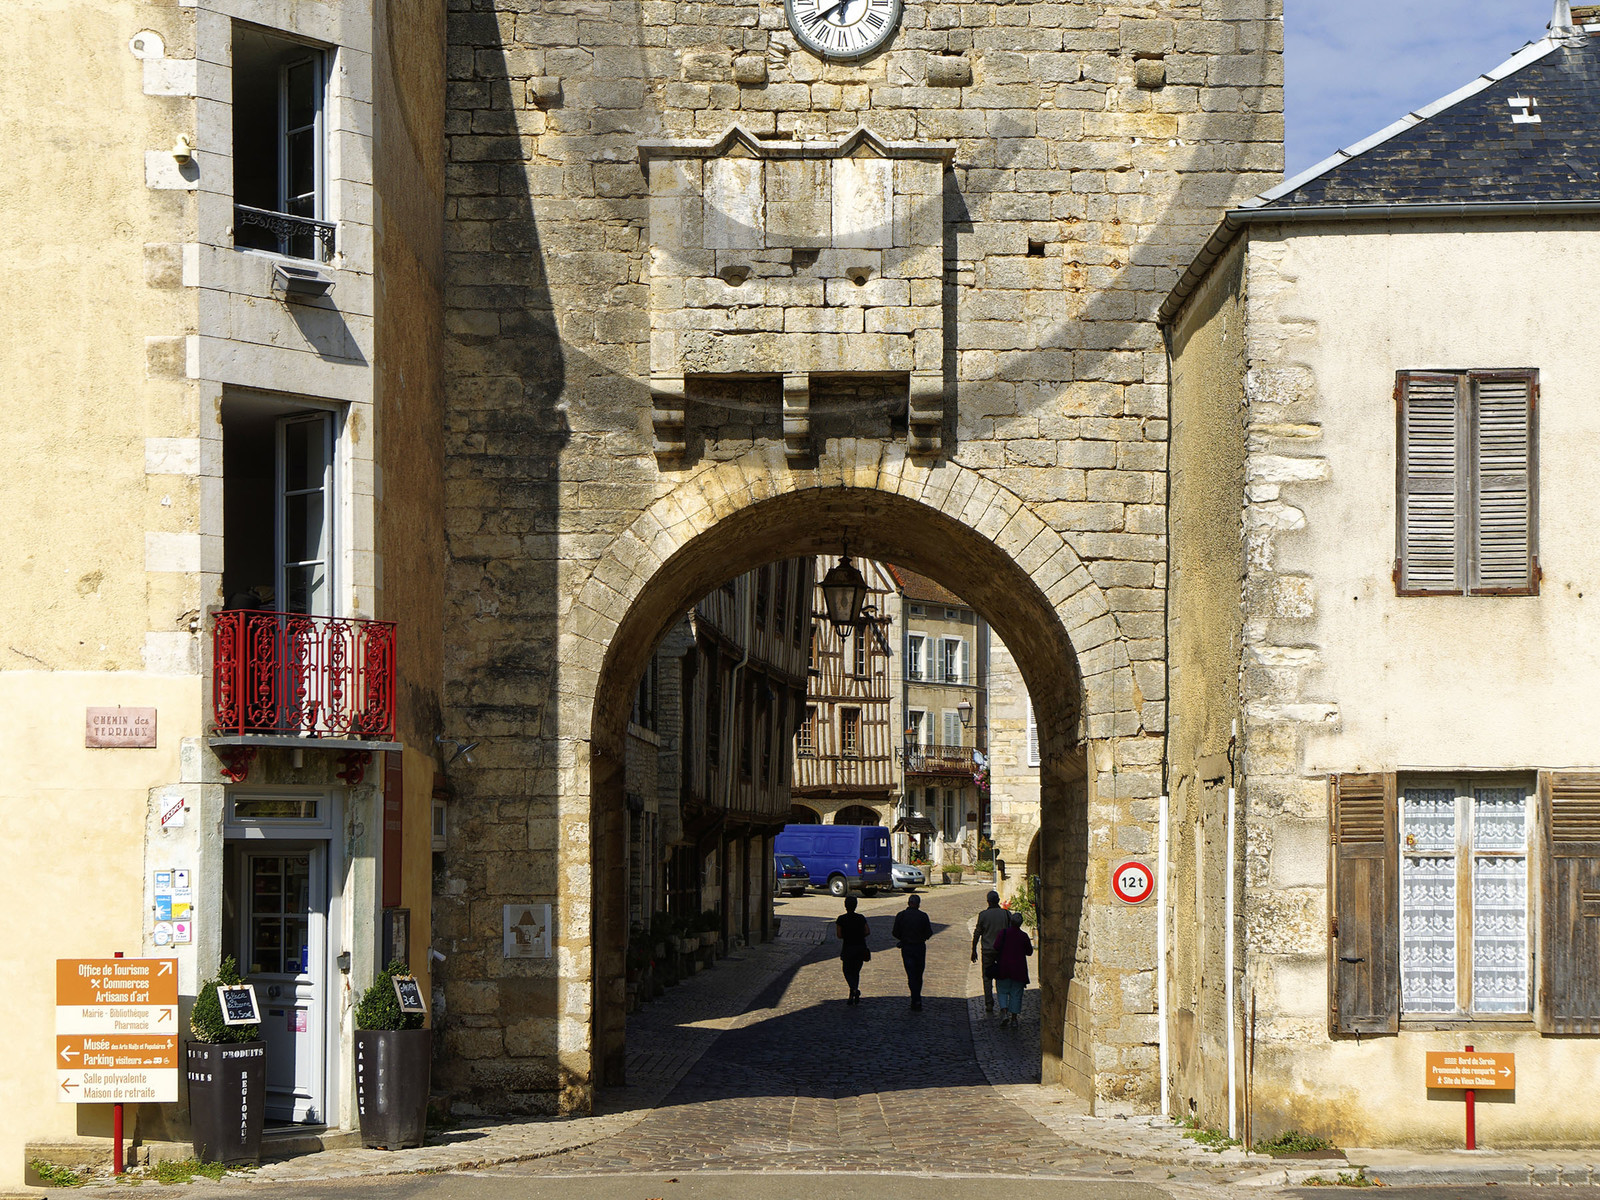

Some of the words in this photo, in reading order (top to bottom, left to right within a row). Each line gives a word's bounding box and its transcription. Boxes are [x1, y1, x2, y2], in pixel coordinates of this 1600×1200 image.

[93, 716, 128, 725] CHEMIN
[134, 716, 149, 725] des
[94, 728, 148, 737] TERREAUX
[78, 964, 101, 977] Office
[102, 964, 112, 976] de
[113, 963, 149, 975] Tourisme
[103, 977, 149, 989] Commerces
[95, 991, 129, 1002] Artisans
[129, 991, 149, 1002] d'art
[82, 1008, 104, 1018] Mairie
[114, 1020, 149, 1029] Pharmacie
[83, 1038, 110, 1050] Musée
[222, 1048, 264, 1059] PRODUITS
[83, 1053, 114, 1067] Parking
[115, 1056, 142, 1065] visiteurs
[83, 1073, 102, 1084] Salle
[103, 1073, 147, 1085] polyvalente
[83, 1087, 112, 1098] Maison
[113, 1087, 123, 1098] de
[124, 1087, 156, 1098] retraite
